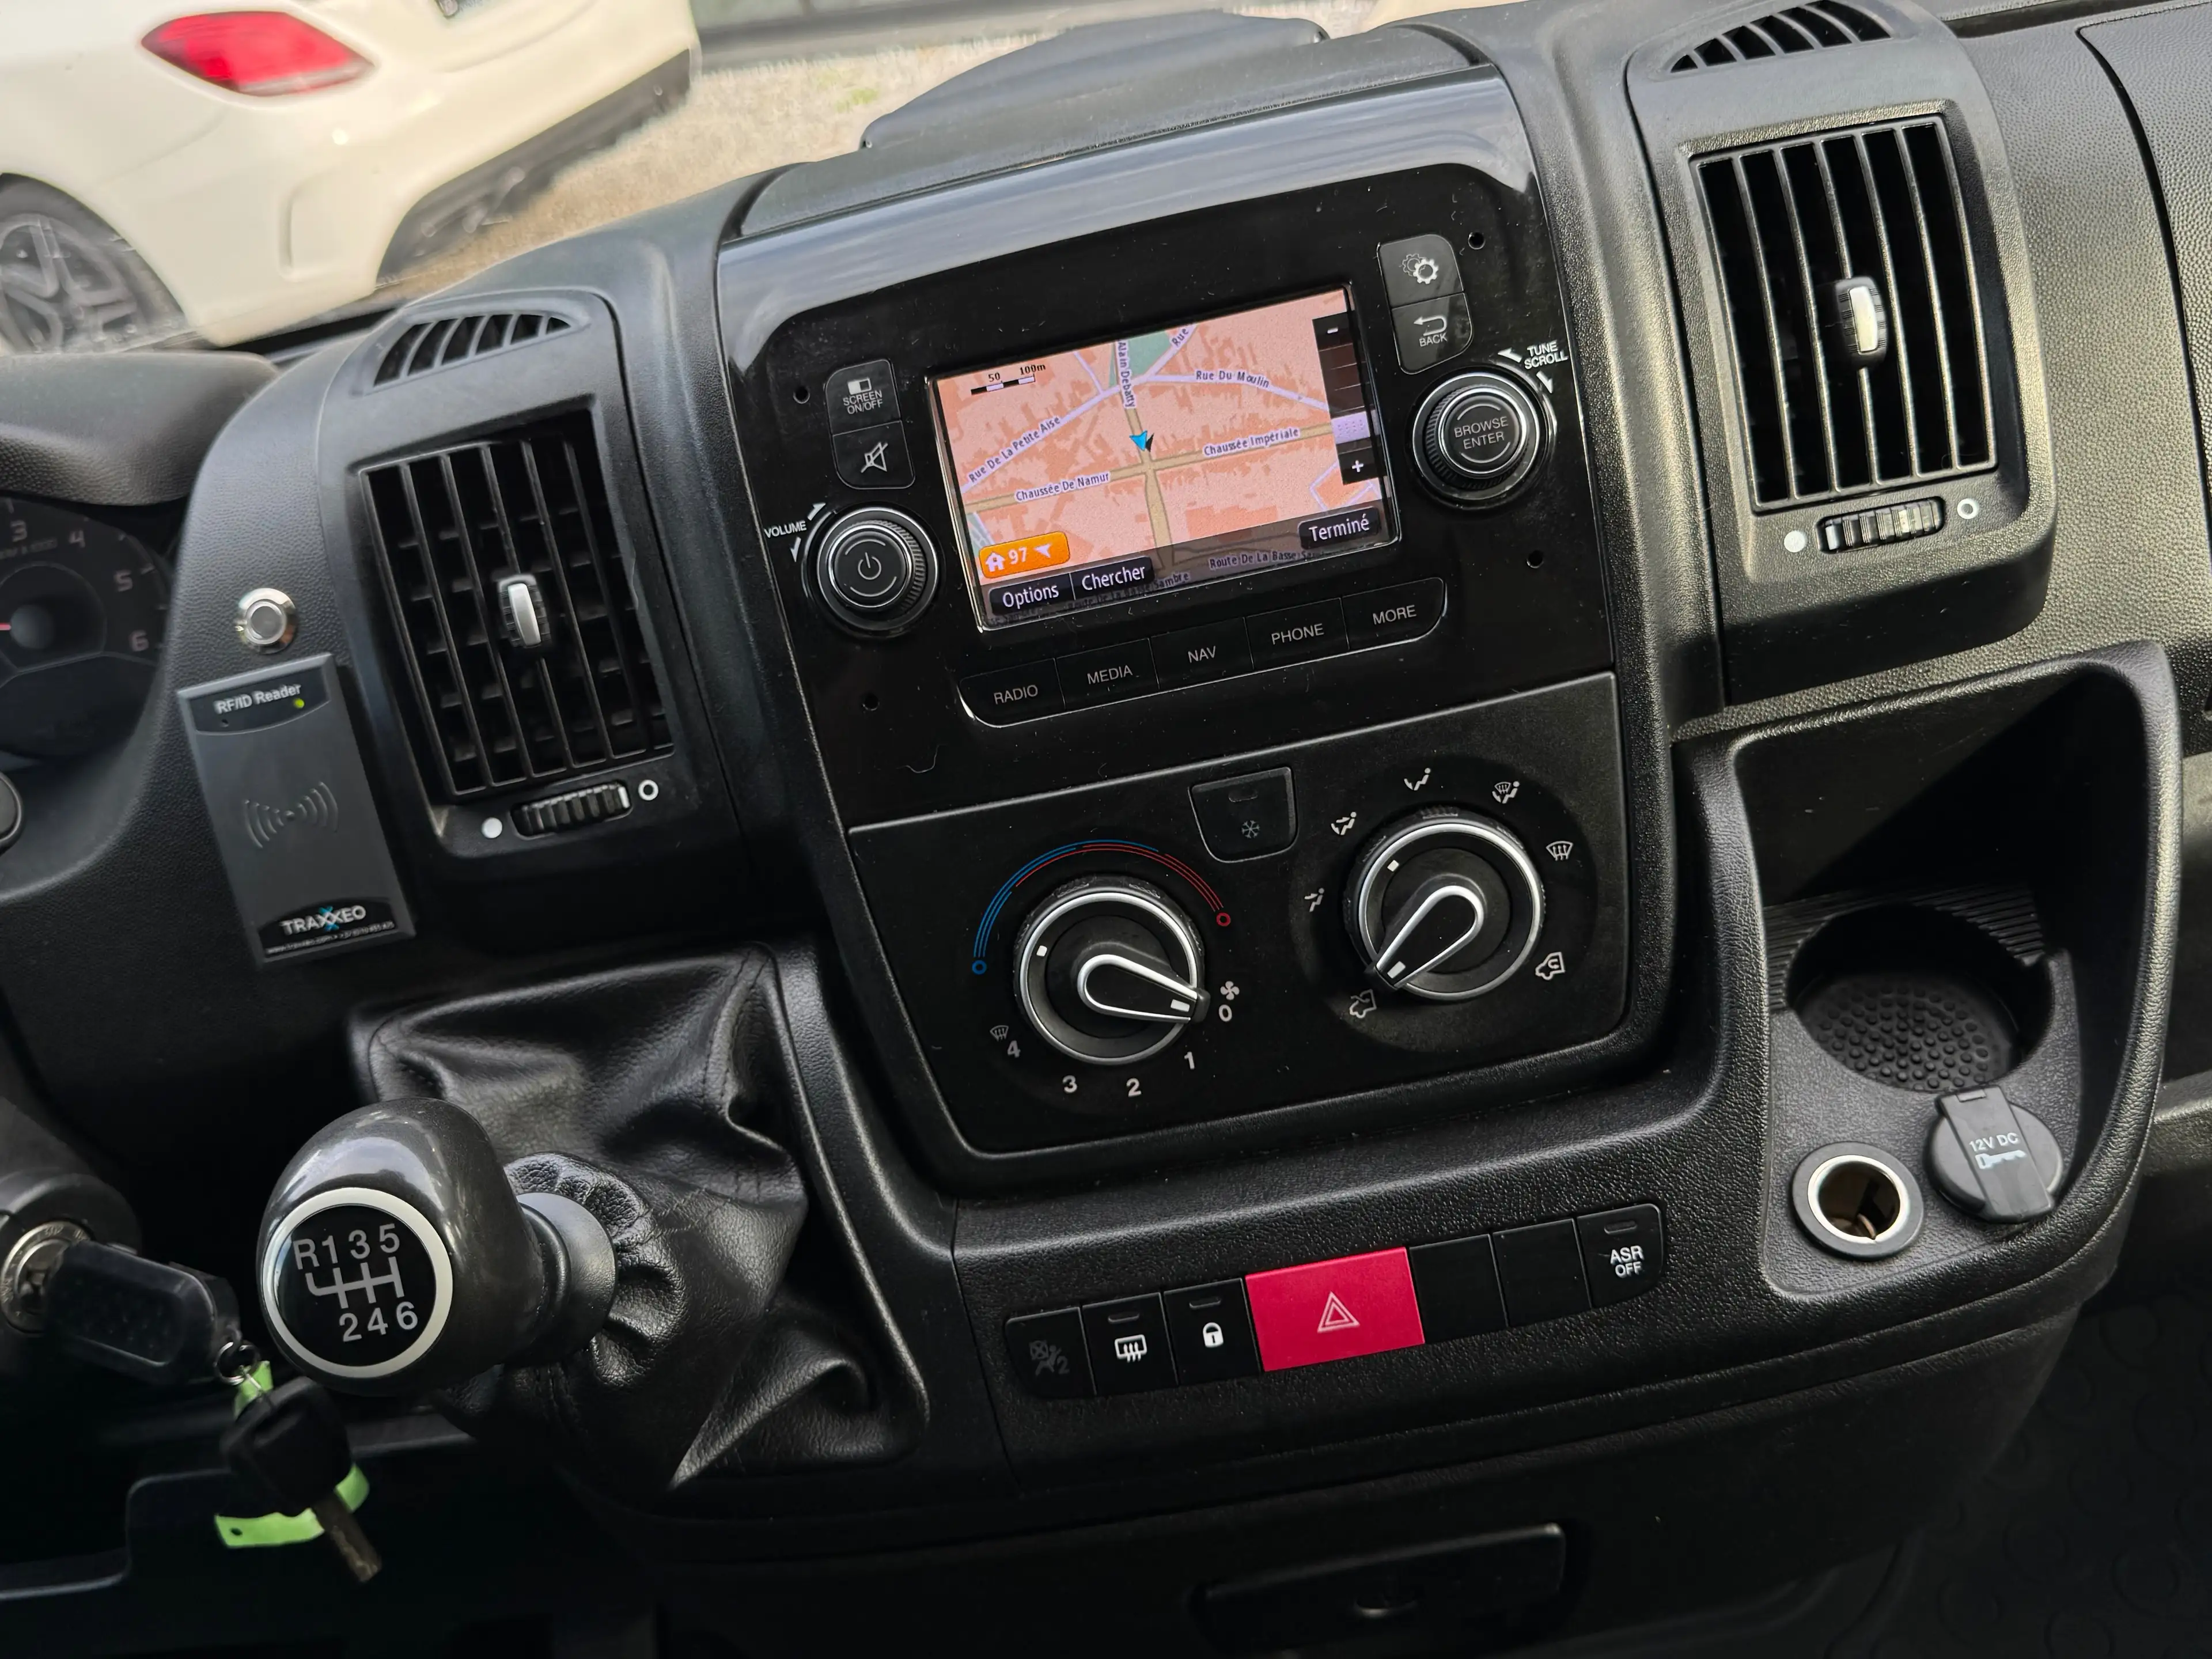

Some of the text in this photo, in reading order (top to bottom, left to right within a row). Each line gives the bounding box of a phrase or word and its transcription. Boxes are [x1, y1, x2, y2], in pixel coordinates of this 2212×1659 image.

[1172, 328, 1189, 346] Rue
[1419, 334, 1448, 347] BACK
[1527, 340, 1558, 357] TUNE
[1524, 351, 1568, 370] SCROLL
[988, 364, 1046, 382] 50 100m
[1196, 370, 1270, 388] Rue Du Moulin
[843, 390, 883, 406] SCREEN
[847, 399, 883, 415] ON/OFF
[1453, 416, 1509, 438] BROWSE
[1204, 427, 1299, 456] Chaussée Impériale
[1463, 430, 1505, 450] ENTER
[969, 465, 986, 483] Rue
[987, 457, 1001, 469] De
[1003, 448, 1013, 459] La
[1012, 430, 1040, 449] Petite
[1016, 472, 1109, 501] Chaussée De Namur
[10, 520, 27, 542] 3
[763, 521, 807, 539] VOLUME
[1309, 513, 1370, 542] Terminé
[69, 529, 85, 548] 4
[1008, 547, 1028, 565] 97
[1210, 556, 1237, 569] Route
[1242, 554, 1254, 564] De
[1257, 551, 1268, 562] La
[1272, 550, 1296, 561] Basse
[113, 570, 133, 592] 5
[1081, 565, 1146, 592] Chercher
[1154, 573, 1189, 589] Sambre
[1002, 584, 1059, 609] Options
[1373, 605, 1417, 626] MORE
[128, 630, 149, 652] 6
[1271, 623, 1324, 645] PHONE
[1188, 645, 1217, 664] NAV
[1087, 665, 1133, 685] MEDIA
[214, 684, 301, 714] RF/ID Reader
[994, 684, 1038, 705] RADIO
[279, 905, 366, 936] TRAXXEO
[1218, 1004, 1233, 1022] 0
[1007, 1040, 1021, 1058] 4
[1184, 1051, 1195, 1070] 1
[1062, 1075, 1078, 1094] 3
[1126, 1078, 1142, 1097] 2
[1969, 1132, 2019, 1152] 12V DC
[293, 1223, 400, 1270] R 1 3 5
[1610, 1245, 1645, 1265] ASR
[1615, 1261, 1642, 1278] OFF
[339, 1301, 418, 1342] 2 4 6
